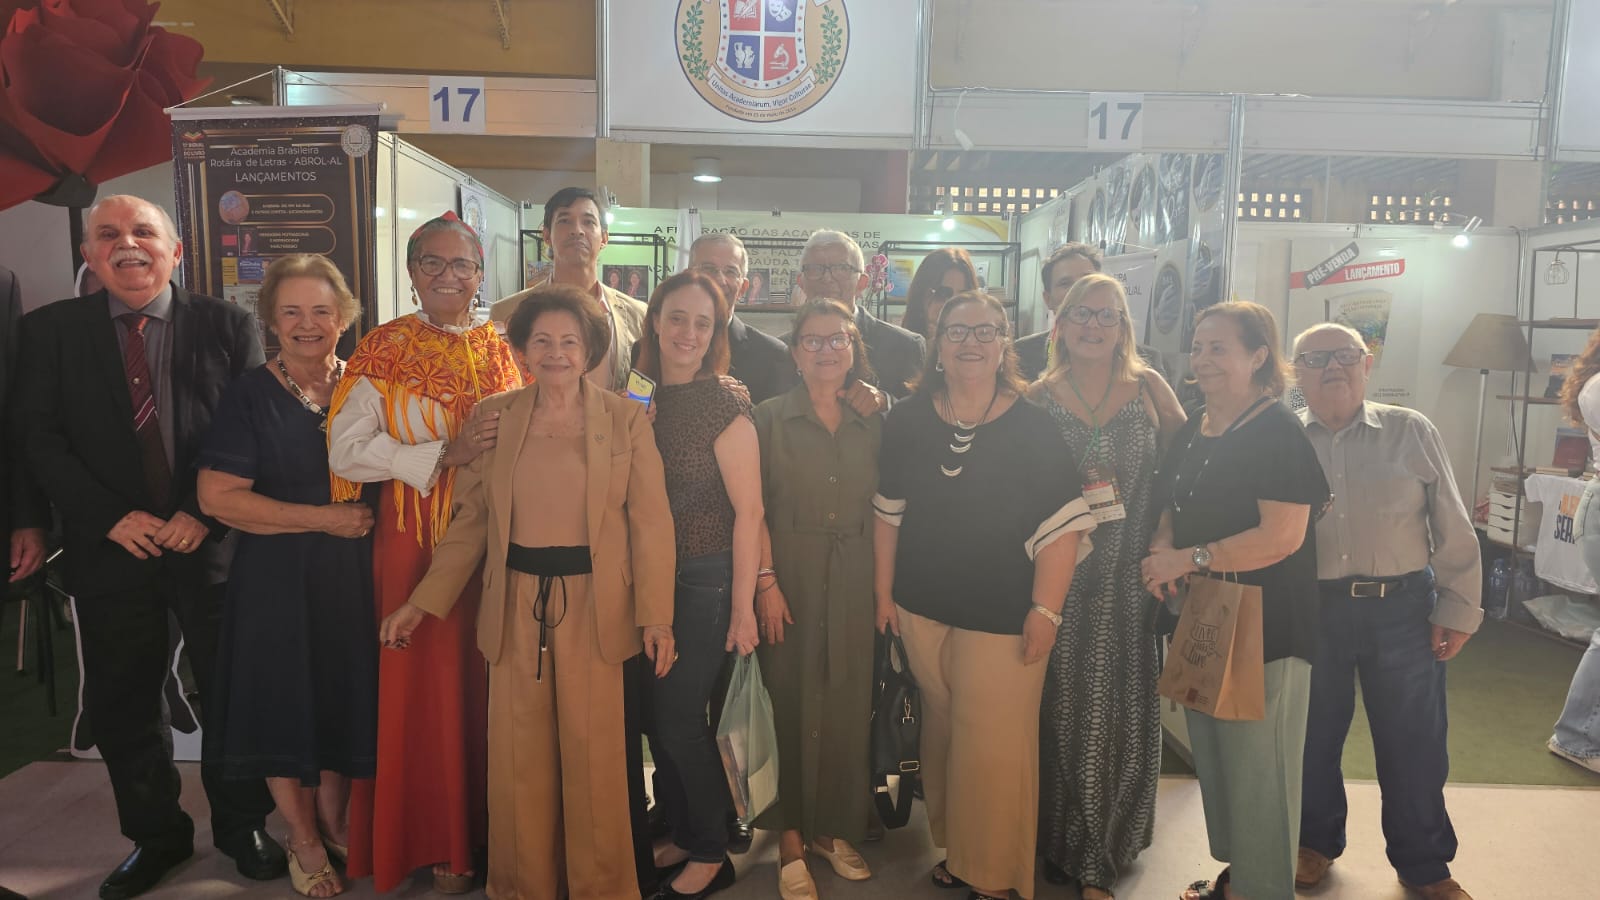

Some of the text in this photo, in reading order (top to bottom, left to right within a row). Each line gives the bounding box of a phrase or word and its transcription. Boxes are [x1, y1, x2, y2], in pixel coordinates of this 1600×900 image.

[433, 86, 480, 122] 17
[1090, 101, 1142, 140] 17
[231, 145, 319, 156] Academia Brasileira
[210, 158, 242, 167] Rotária
[246, 158, 258, 167] de
[260, 158, 287, 167] Letras
[293, 157, 342, 166] ABROL-AL
[235, 171, 317, 184] LANÇAMENTOS
[751, 228, 779, 237] DAS
[863, 231, 881, 239] DE
[1344, 262, 1400, 281] LANÇAMENTO
